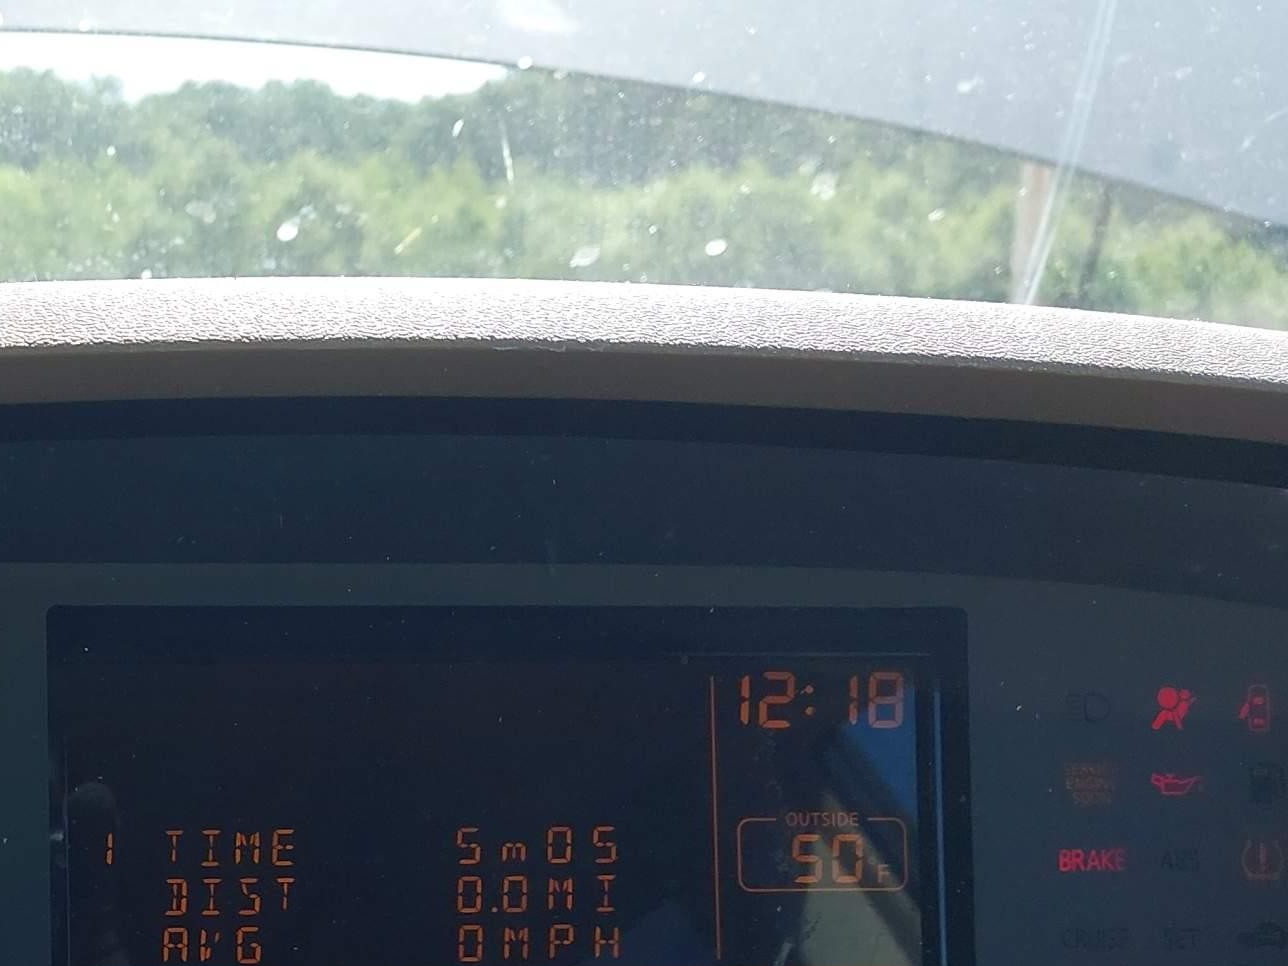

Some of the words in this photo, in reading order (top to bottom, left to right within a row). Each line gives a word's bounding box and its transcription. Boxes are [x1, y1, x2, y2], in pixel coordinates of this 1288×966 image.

[738, 671, 905, 728] 12:18
[784, 811, 860, 828] OUTSIDE
[164, 828, 297, 867] TIME
[1058, 849, 1127, 873] BRAKE
[164, 876, 297, 917] DIST
[162, 926, 263, 966] AVG
